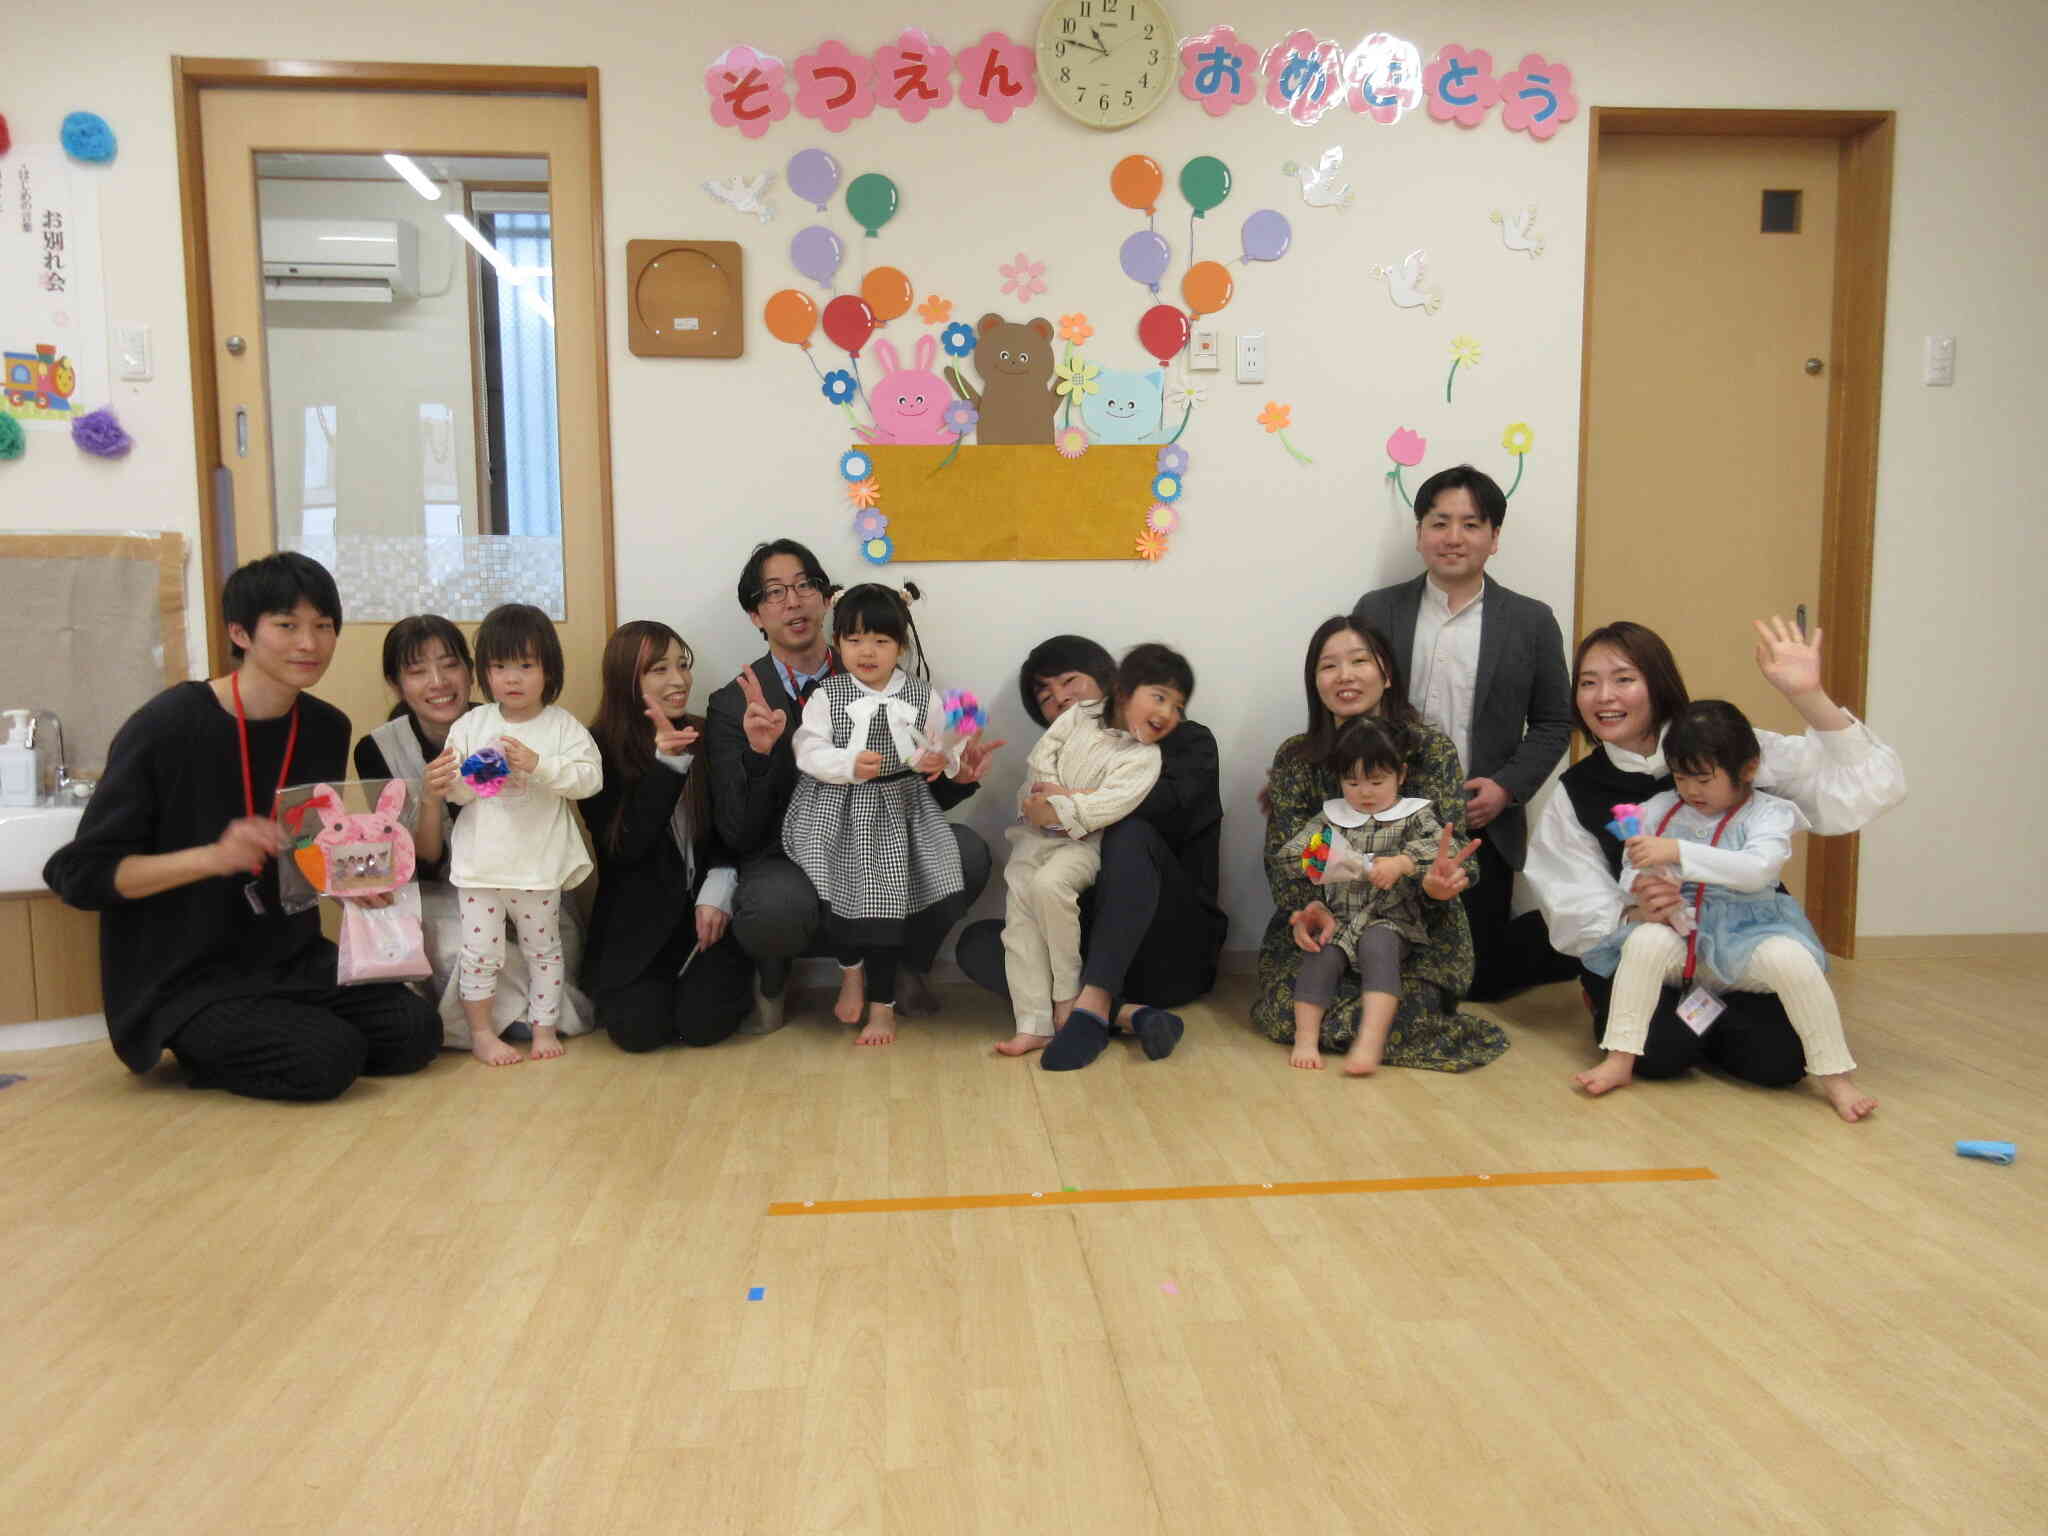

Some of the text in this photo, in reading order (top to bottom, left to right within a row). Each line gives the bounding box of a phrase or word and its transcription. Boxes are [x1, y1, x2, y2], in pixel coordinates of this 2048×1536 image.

[1080, 1, 1091, 18] 11
[1102, 0, 1117, 13] 12
[1062, 18, 1076, 34] 10
[1144, 24, 1154, 40] 2
[1055, 41, 1066, 58] 9
[1148, 49, 1159, 66] 3
[1060, 67, 1071, 83] 8
[1138, 72, 1149, 88] 4
[723, 49, 1023, 120] そつえん
[1076, 86, 1086, 103] 7
[1099, 94, 1109, 111] 6
[1122, 90, 1133, 106] 5
[42, 209, 65, 292] お別れ会
